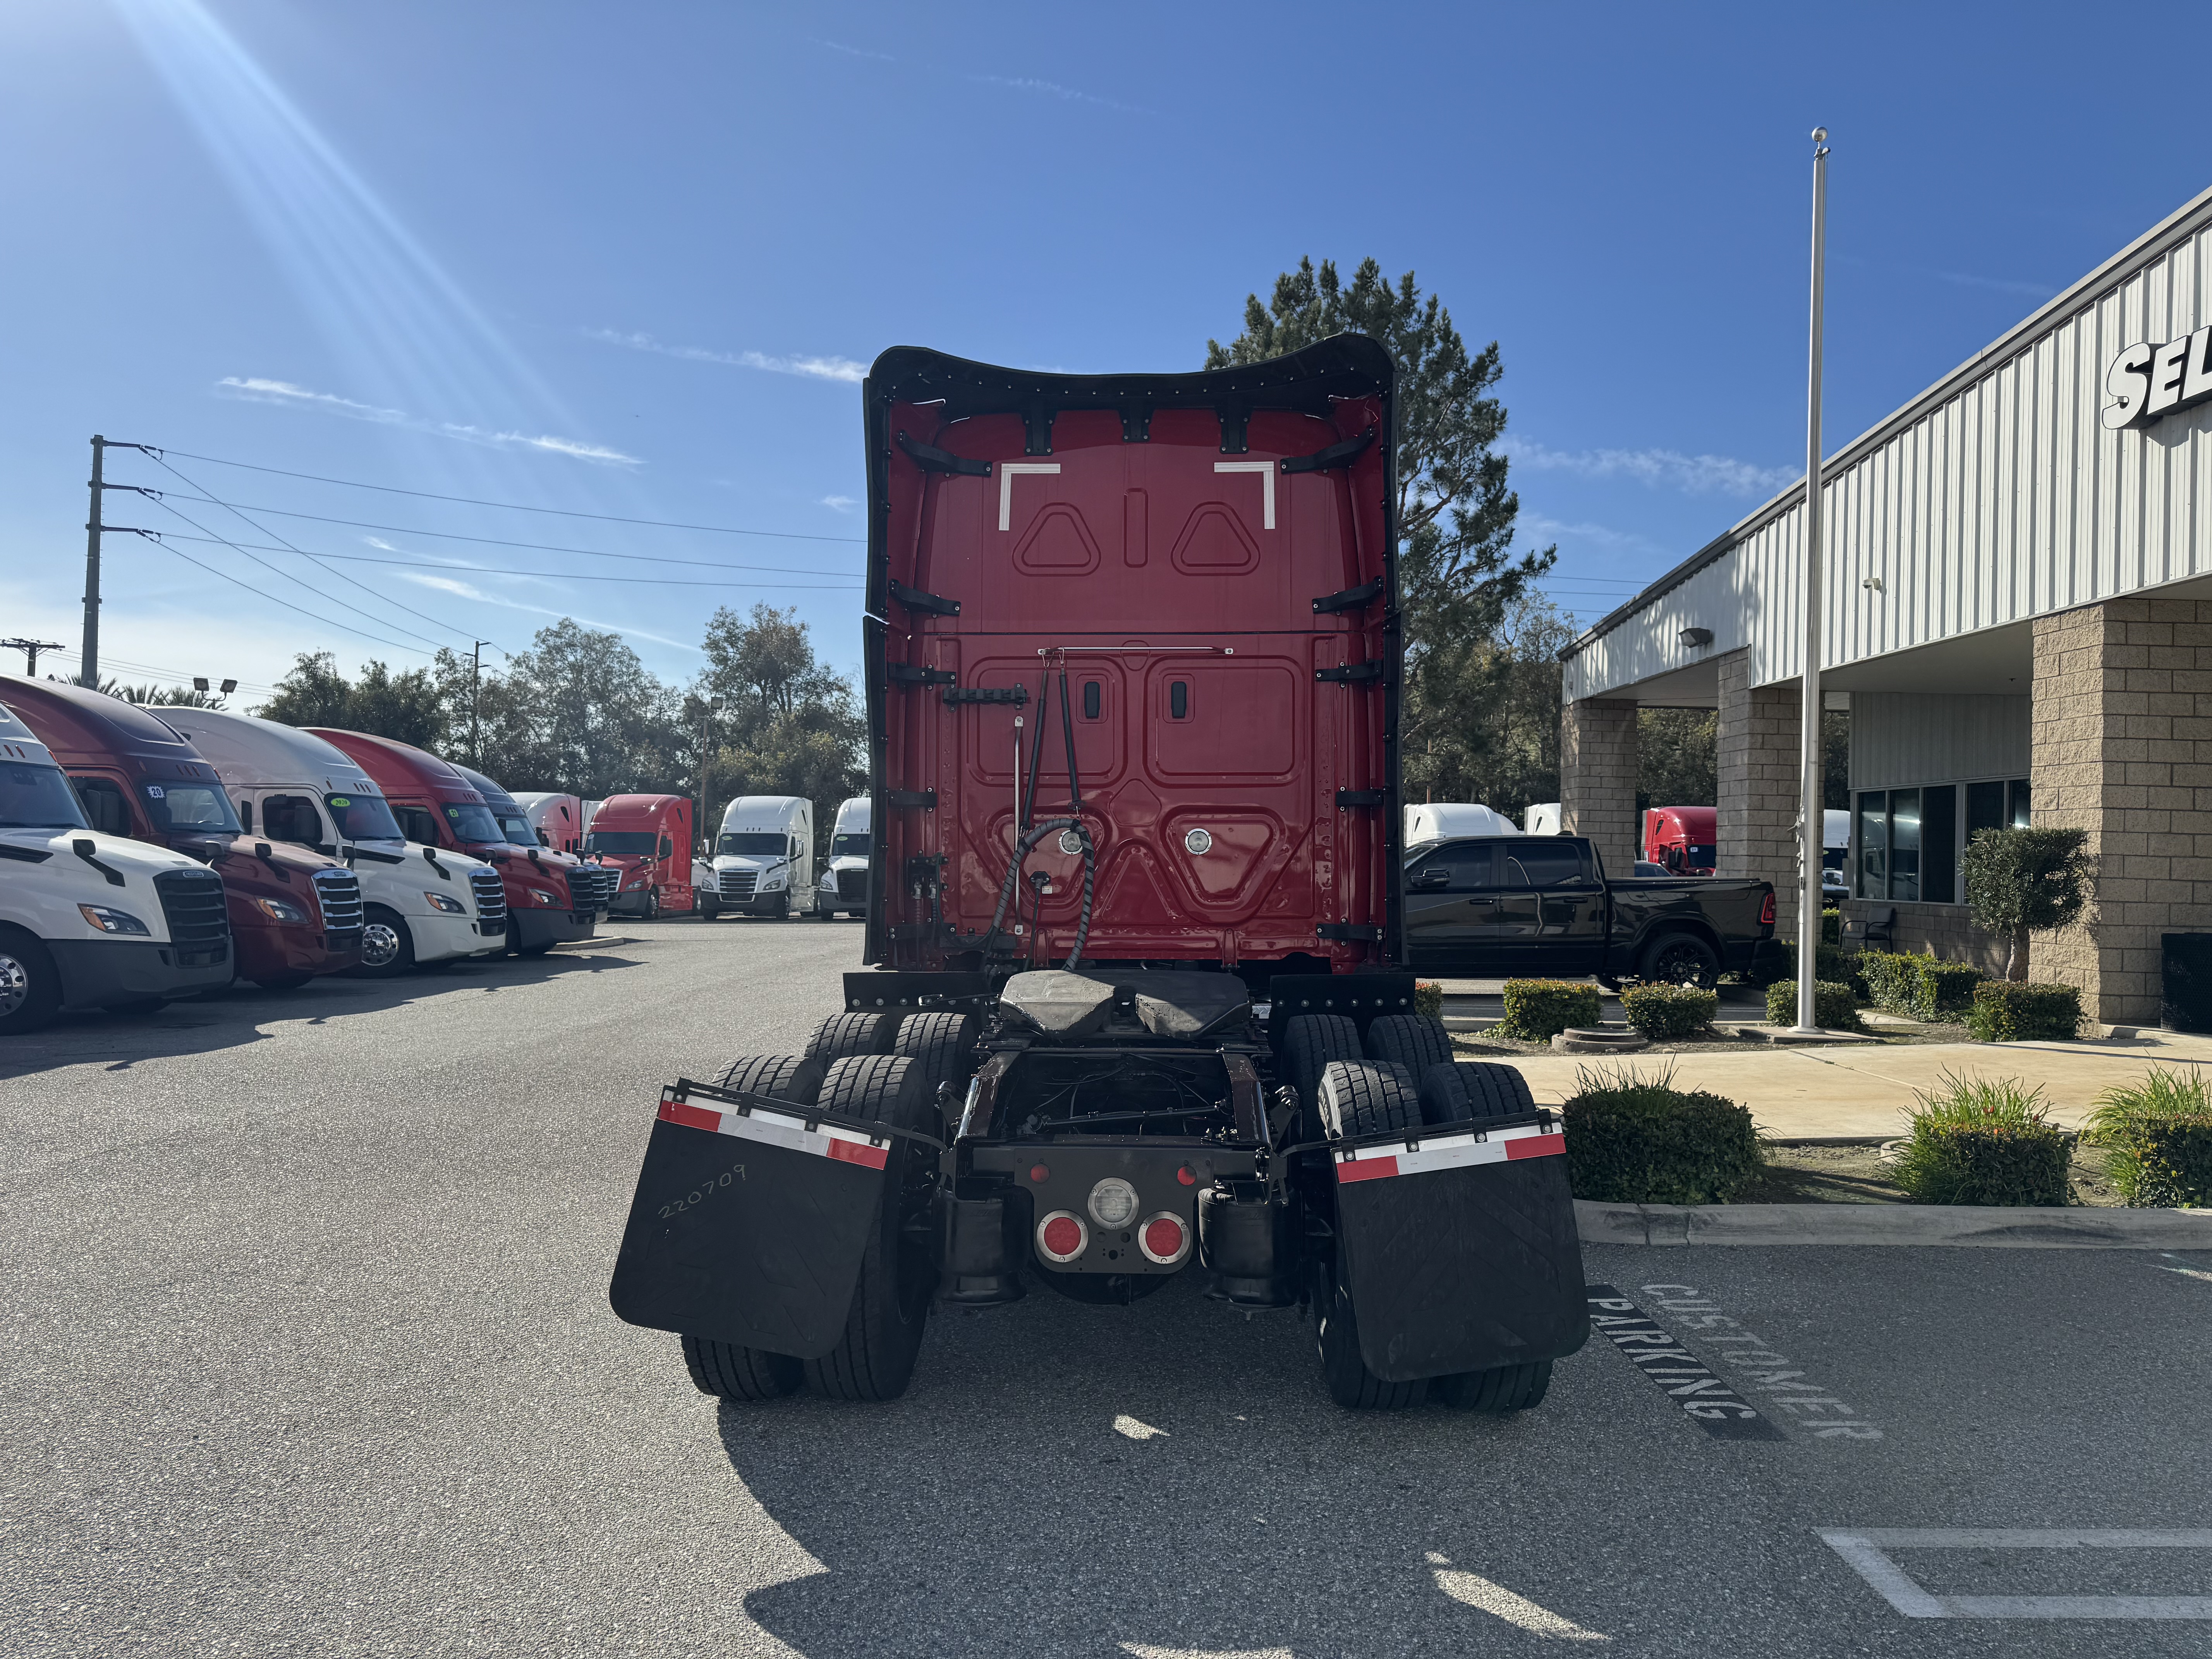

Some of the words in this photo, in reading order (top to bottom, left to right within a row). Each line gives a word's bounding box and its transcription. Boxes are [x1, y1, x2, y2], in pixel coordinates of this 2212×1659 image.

[151, 788, 161, 796] 20
[658, 1164, 746, 1218] 220709
[1587, 1298, 1757, 1419] PARKING
[1641, 1284, 1884, 1439] CUSTOMER
